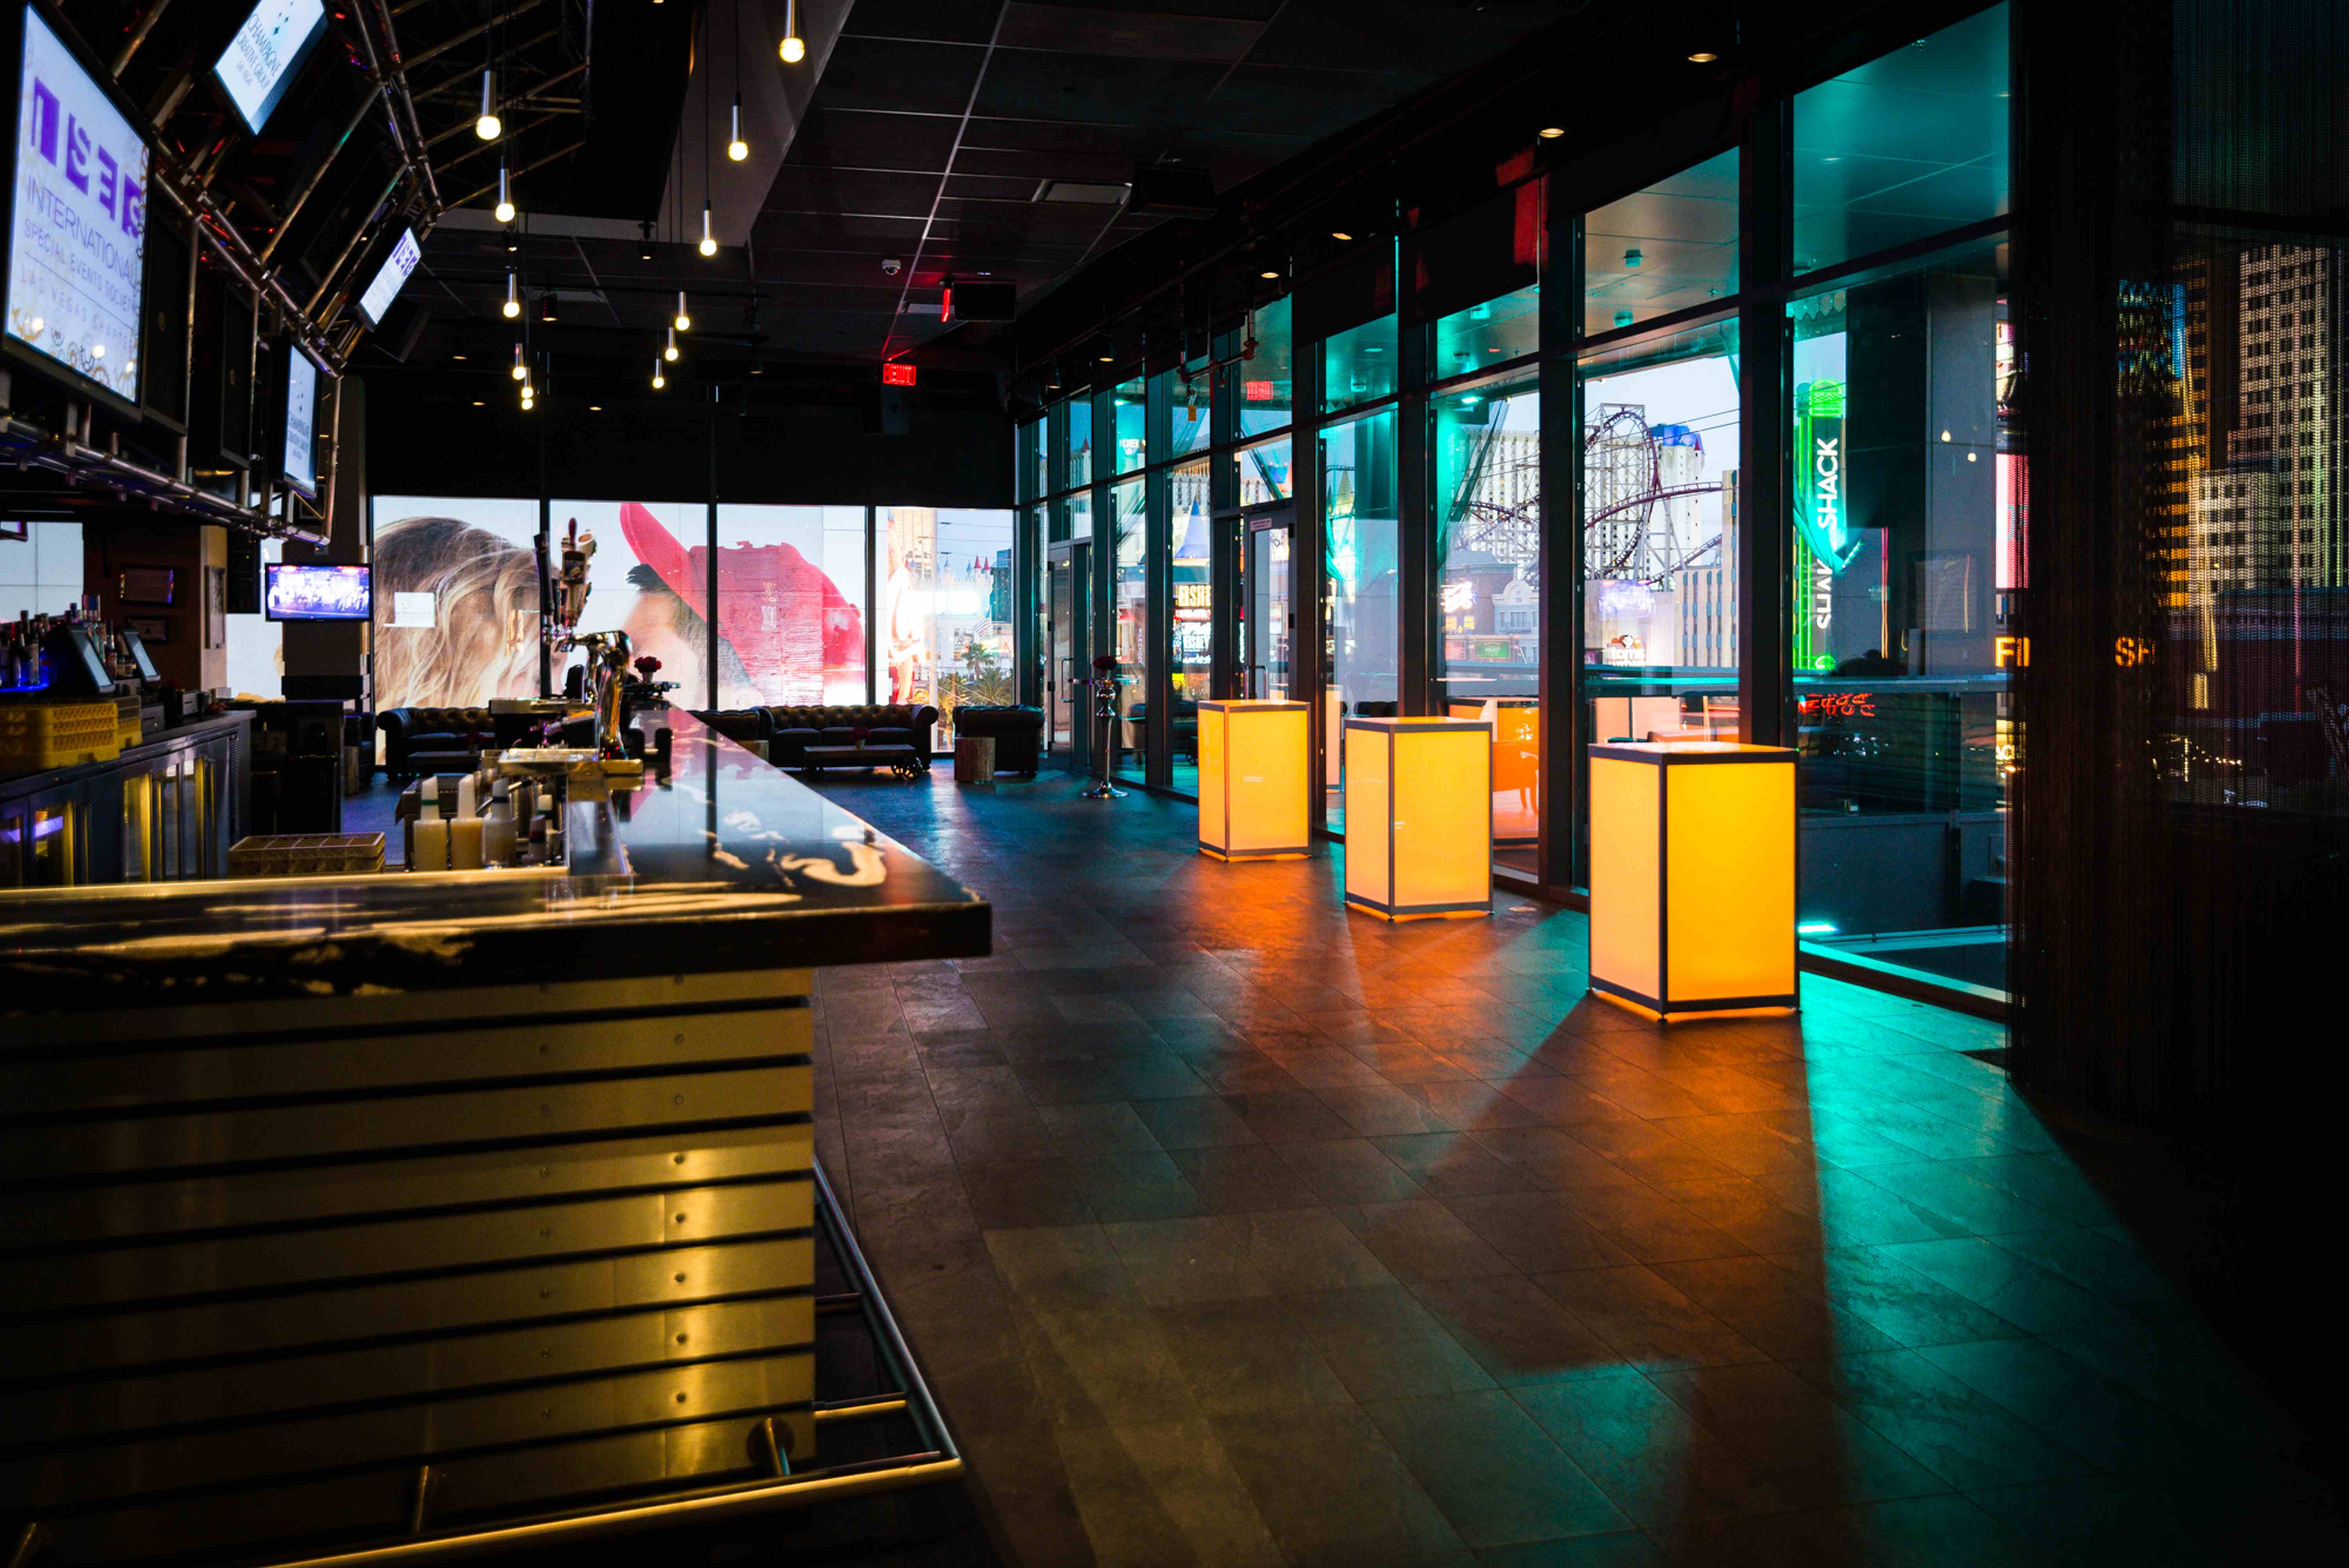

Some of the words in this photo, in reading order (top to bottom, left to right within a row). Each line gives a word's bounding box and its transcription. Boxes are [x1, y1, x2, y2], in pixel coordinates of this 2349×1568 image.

[247, 13, 281, 78] CHAMPAGNE
[24, 218, 66, 265] SPECIAL
[70, 253, 102, 292] EVENTS
[27, 174, 136, 290] INTERNATIONAL
[1817, 437, 1838, 529] SHACK
